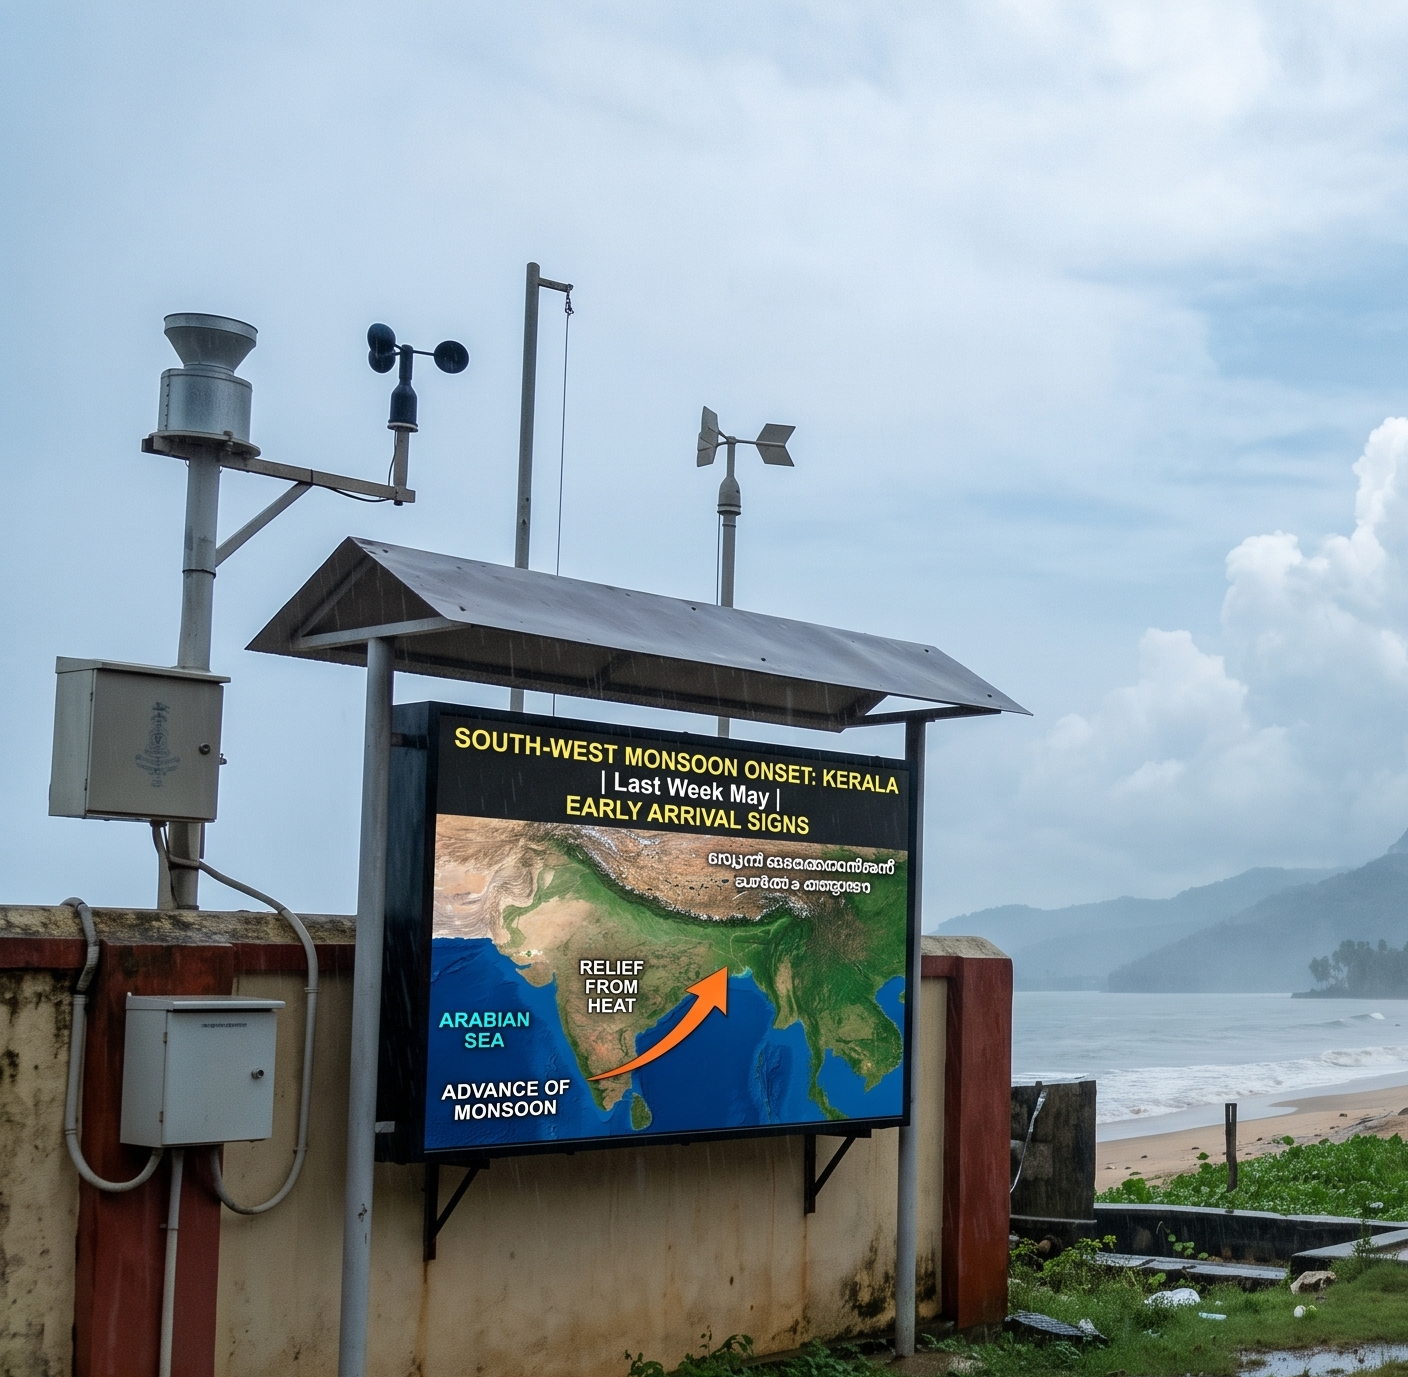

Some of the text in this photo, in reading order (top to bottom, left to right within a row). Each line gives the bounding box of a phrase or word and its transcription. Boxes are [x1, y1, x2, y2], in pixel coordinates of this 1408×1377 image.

[454, 727, 899, 795] SOUTH-WEST MONSOON ONSET: KERALA
[614, 771, 661, 796] Last
[666, 777, 724, 802] Week
[730, 783, 770, 811] May
[566, 794, 810, 835] EARLY ARRIVAL SIGNS
[580, 960, 644, 976] RELIEF
[585, 979, 638, 994] FROM
[588, 998, 637, 1013] HEAT
[438, 1011, 530, 1028] ARABIAN
[464, 1032, 505, 1049] SEA
[441, 1079, 571, 1101] ADVANCE OF
[454, 1100, 557, 1121] MONSOON
